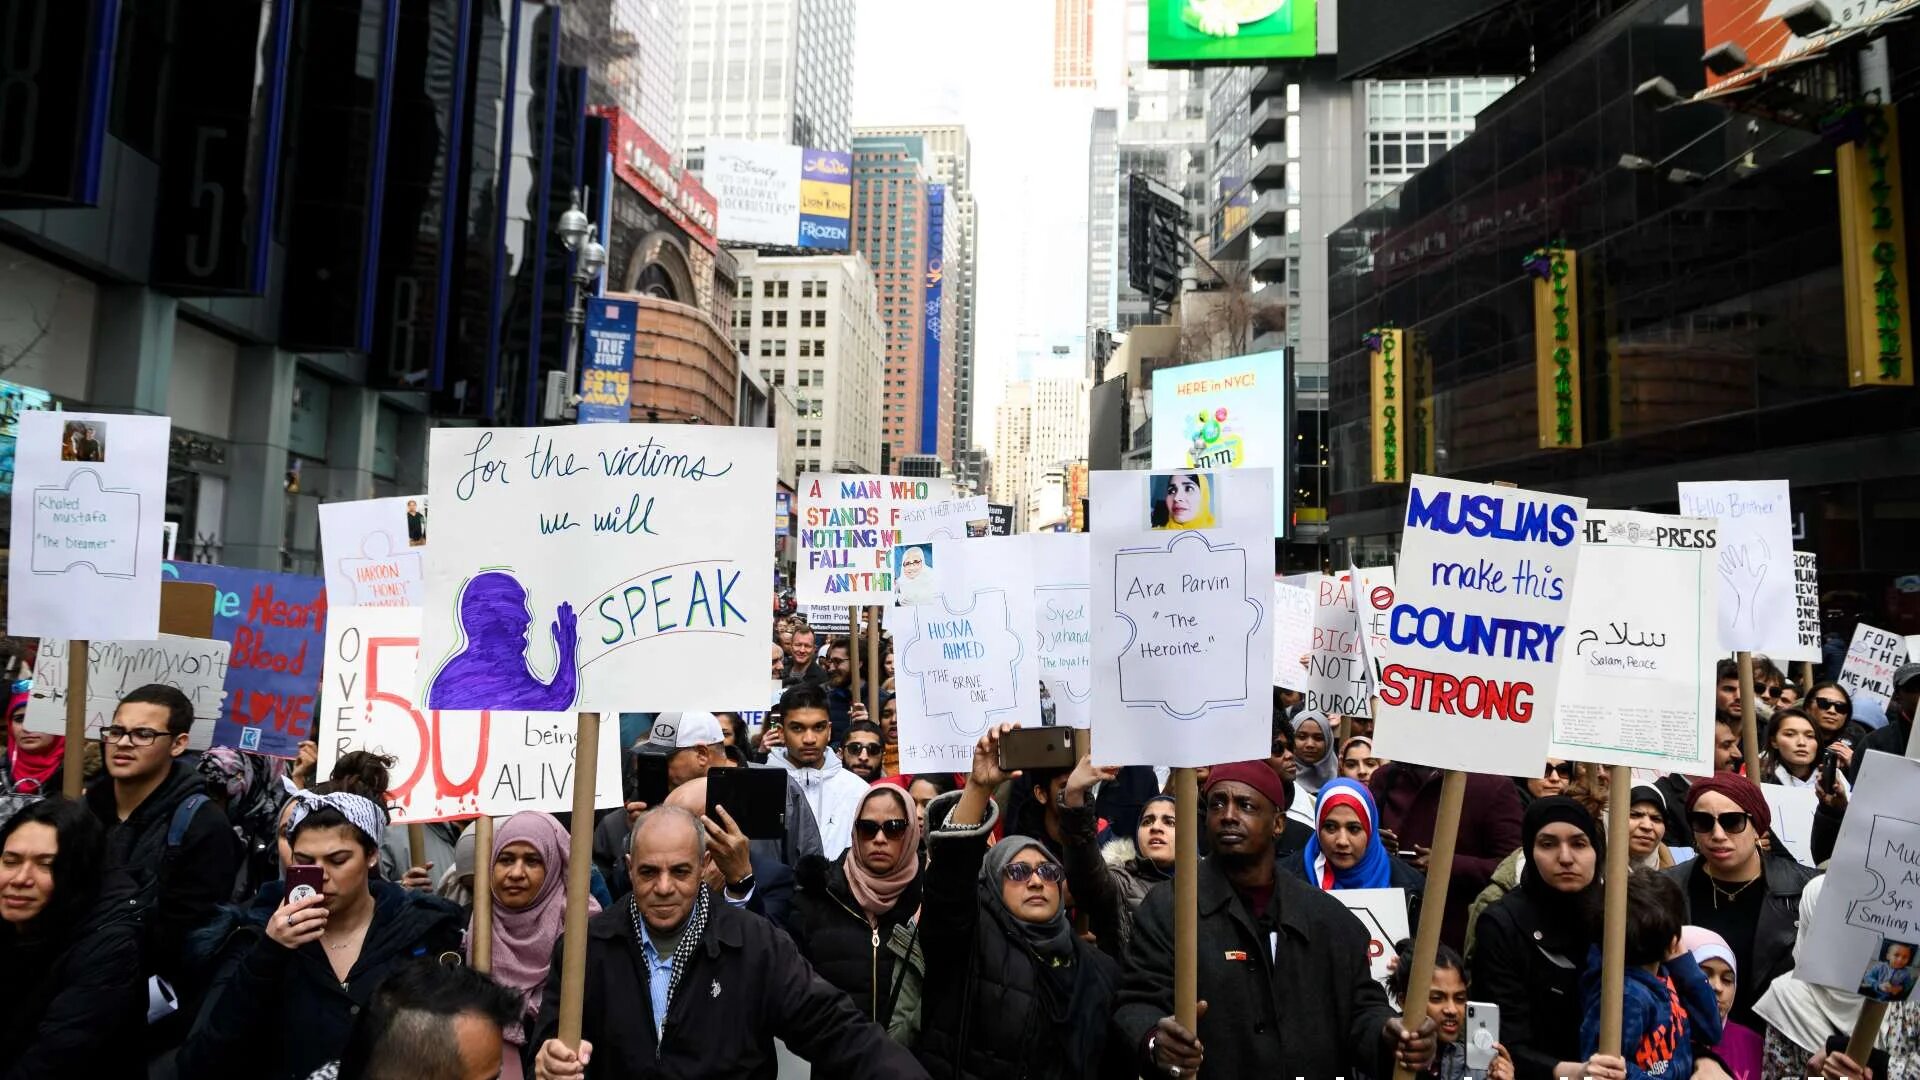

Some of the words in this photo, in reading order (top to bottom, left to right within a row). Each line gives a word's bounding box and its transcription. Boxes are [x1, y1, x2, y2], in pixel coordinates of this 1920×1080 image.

[722, 184, 778, 201] BROADWAY
[802, 194, 823, 208] LION
[825, 198, 847, 211] KING
[800, 220, 847, 240] FROZEN
[596, 338, 625, 355] TRUE
[594, 352, 624, 367] STORY
[584, 369, 630, 382] COME
[1177, 380, 1209, 396] HERE
[1211, 383, 1221, 393] in
[1224, 373, 1256, 390] NYC!
[524, 435, 590, 480] the
[809, 480, 822, 499] A
[840, 481, 882, 500] MAN
[889, 481, 929, 500] WHO
[540, 512, 581, 535] we
[594, 492, 660, 536] will
[806, 506, 880, 528] STANDS
[1407, 487, 1579, 547] MUSLIMS
[801, 528, 878, 549] NOTHING
[1656, 526, 1717, 549] PRESS
[809, 549, 856, 570] FALL
[1126, 576, 1167, 602] Ara
[1181, 574, 1230, 593] Parvin
[1432, 558, 1508, 594] make
[1512, 559, 1564, 601] this
[246, 584, 329, 634] Heart
[599, 568, 748, 646] SPEAK
[811, 612, 832, 621] From
[1045, 598, 1084, 625] Syed
[928, 619, 974, 640] HUSNA
[1390, 603, 1566, 663] COUNTRY
[1863, 630, 1898, 651] FOR
[230, 625, 308, 676] Blood
[943, 640, 985, 661] AHMED
[1869, 647, 1903, 668] THE
[37, 660, 63, 687] Kil
[1310, 654, 1357, 682] NOT
[952, 674, 984, 690] BRAVE
[1379, 663, 1534, 723] STRONG
[1841, 669, 1861, 687] WE
[1861, 677, 1892, 698] WILL
[1307, 689, 1369, 716] BURQA
[491, 762, 602, 802] ALIV
[1881, 890, 1914, 911] 3yrs
[1859, 905, 1909, 934] Smiling
